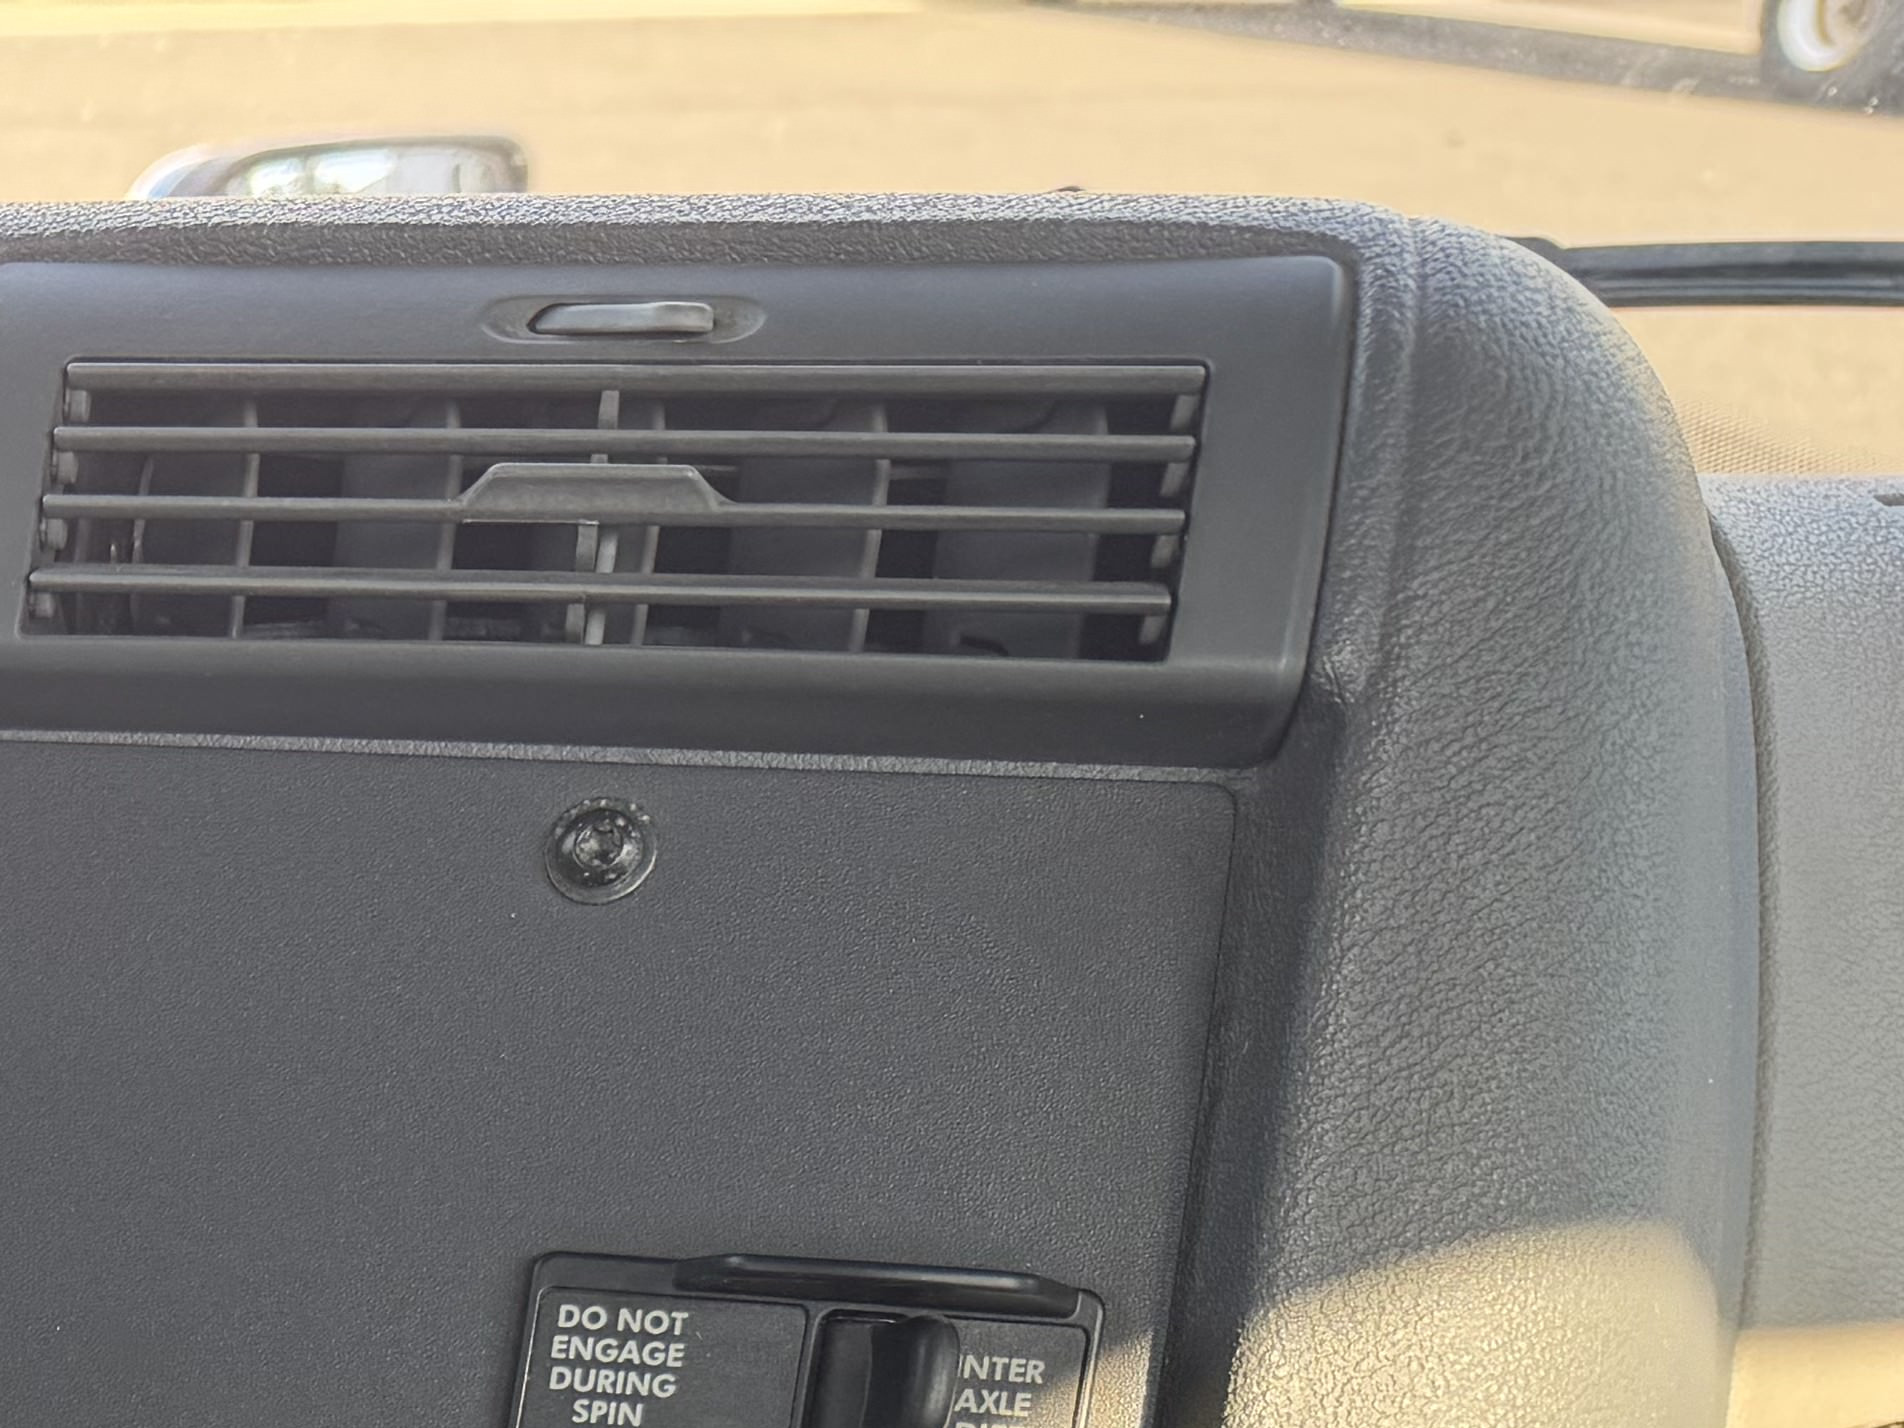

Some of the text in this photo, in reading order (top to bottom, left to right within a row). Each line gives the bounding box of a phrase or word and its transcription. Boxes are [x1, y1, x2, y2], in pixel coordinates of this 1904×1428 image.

[558, 1304, 688, 1335] DO NOT
[550, 1335, 686, 1368] ENGAGE
[548, 1366, 677, 1398] DURING
[572, 1399, 643, 1428] SPIN
[953, 1389, 1032, 1418] AXLE
